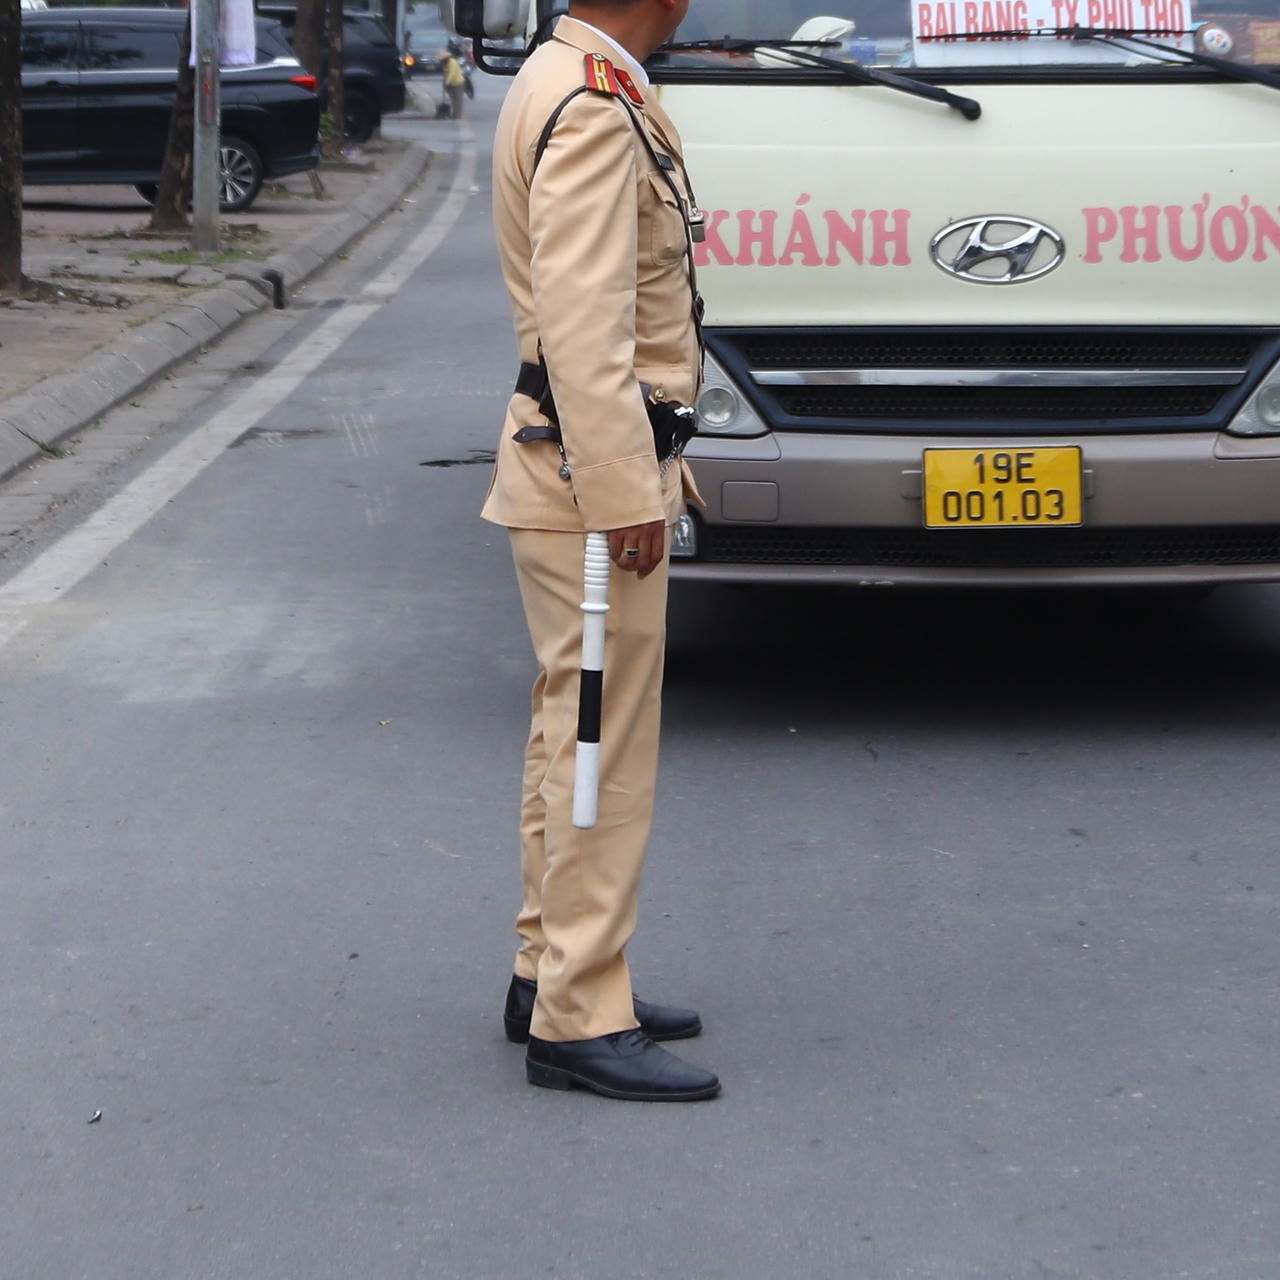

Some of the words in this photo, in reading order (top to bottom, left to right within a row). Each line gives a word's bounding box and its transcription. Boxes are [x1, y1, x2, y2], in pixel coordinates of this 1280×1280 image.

[1051, 0, 1079, 40] TX
[694, 192, 912, 266] KHÁNH
[973, 452, 1036, 484] 19E
[942, 488, 1064, 522] 001.03
